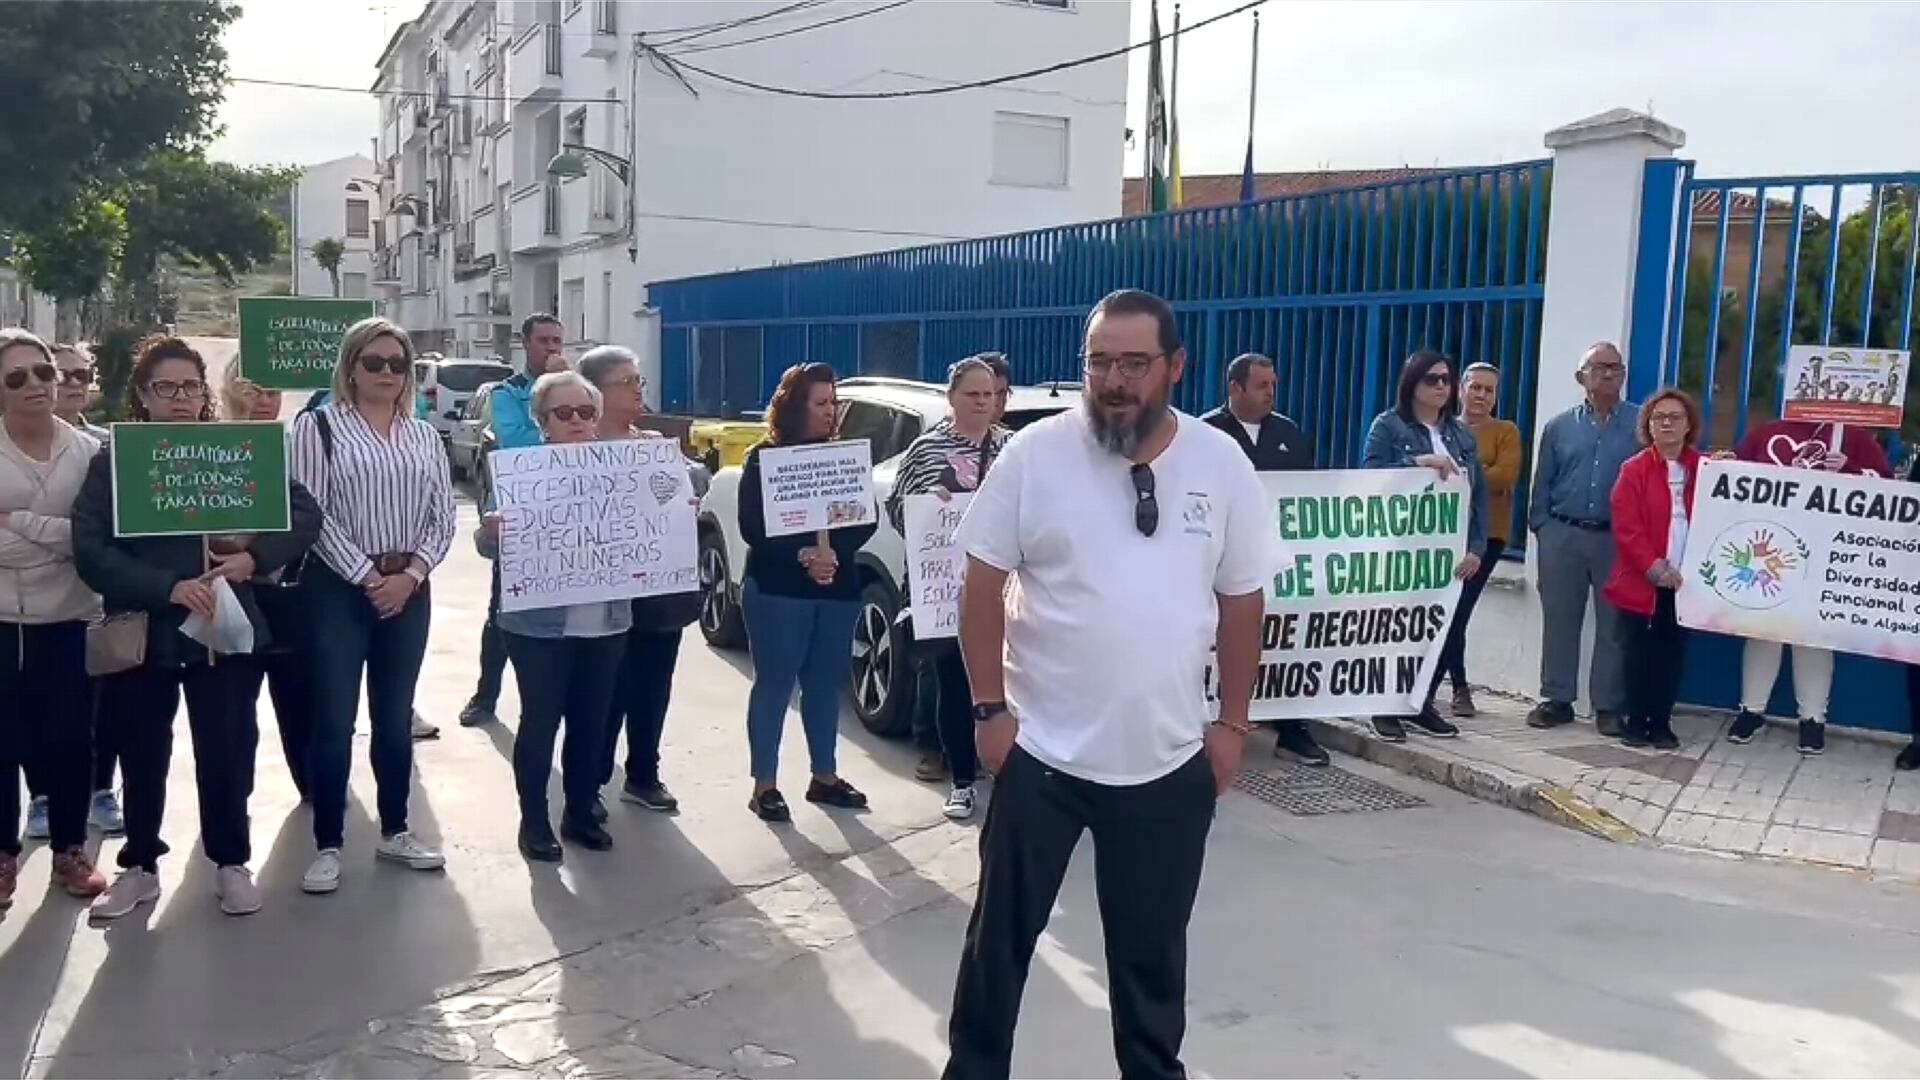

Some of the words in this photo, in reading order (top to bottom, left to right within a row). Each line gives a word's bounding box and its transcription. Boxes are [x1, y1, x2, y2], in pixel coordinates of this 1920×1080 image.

[494, 451, 543, 477] LOS
[548, 443, 651, 470] ALUMNOS
[497, 470, 639, 506] NECESIDADES
[1711, 473, 1800, 508] ASDIF
[1805, 485, 1920, 526] ALGAID
[501, 496, 636, 532] EDUCATIVAS
[1278, 482, 1460, 540] EDUCACIÓN
[501, 519, 638, 556] ESPECIALES
[643, 513, 669, 538] NO
[502, 557, 549, 577] SON
[1325, 548, 1456, 596] CALIDAD
[1868, 552, 1887, 568] la
[1825, 567, 1920, 596] Diversidad
[1820, 590, 1906, 613] Funcional
[1851, 613, 1868, 625] De
[1262, 613, 1300, 651] DE
[1305, 603, 1446, 650] RECURSOS
[1329, 656, 1386, 696] CON
[1396, 655, 1425, 694] N
